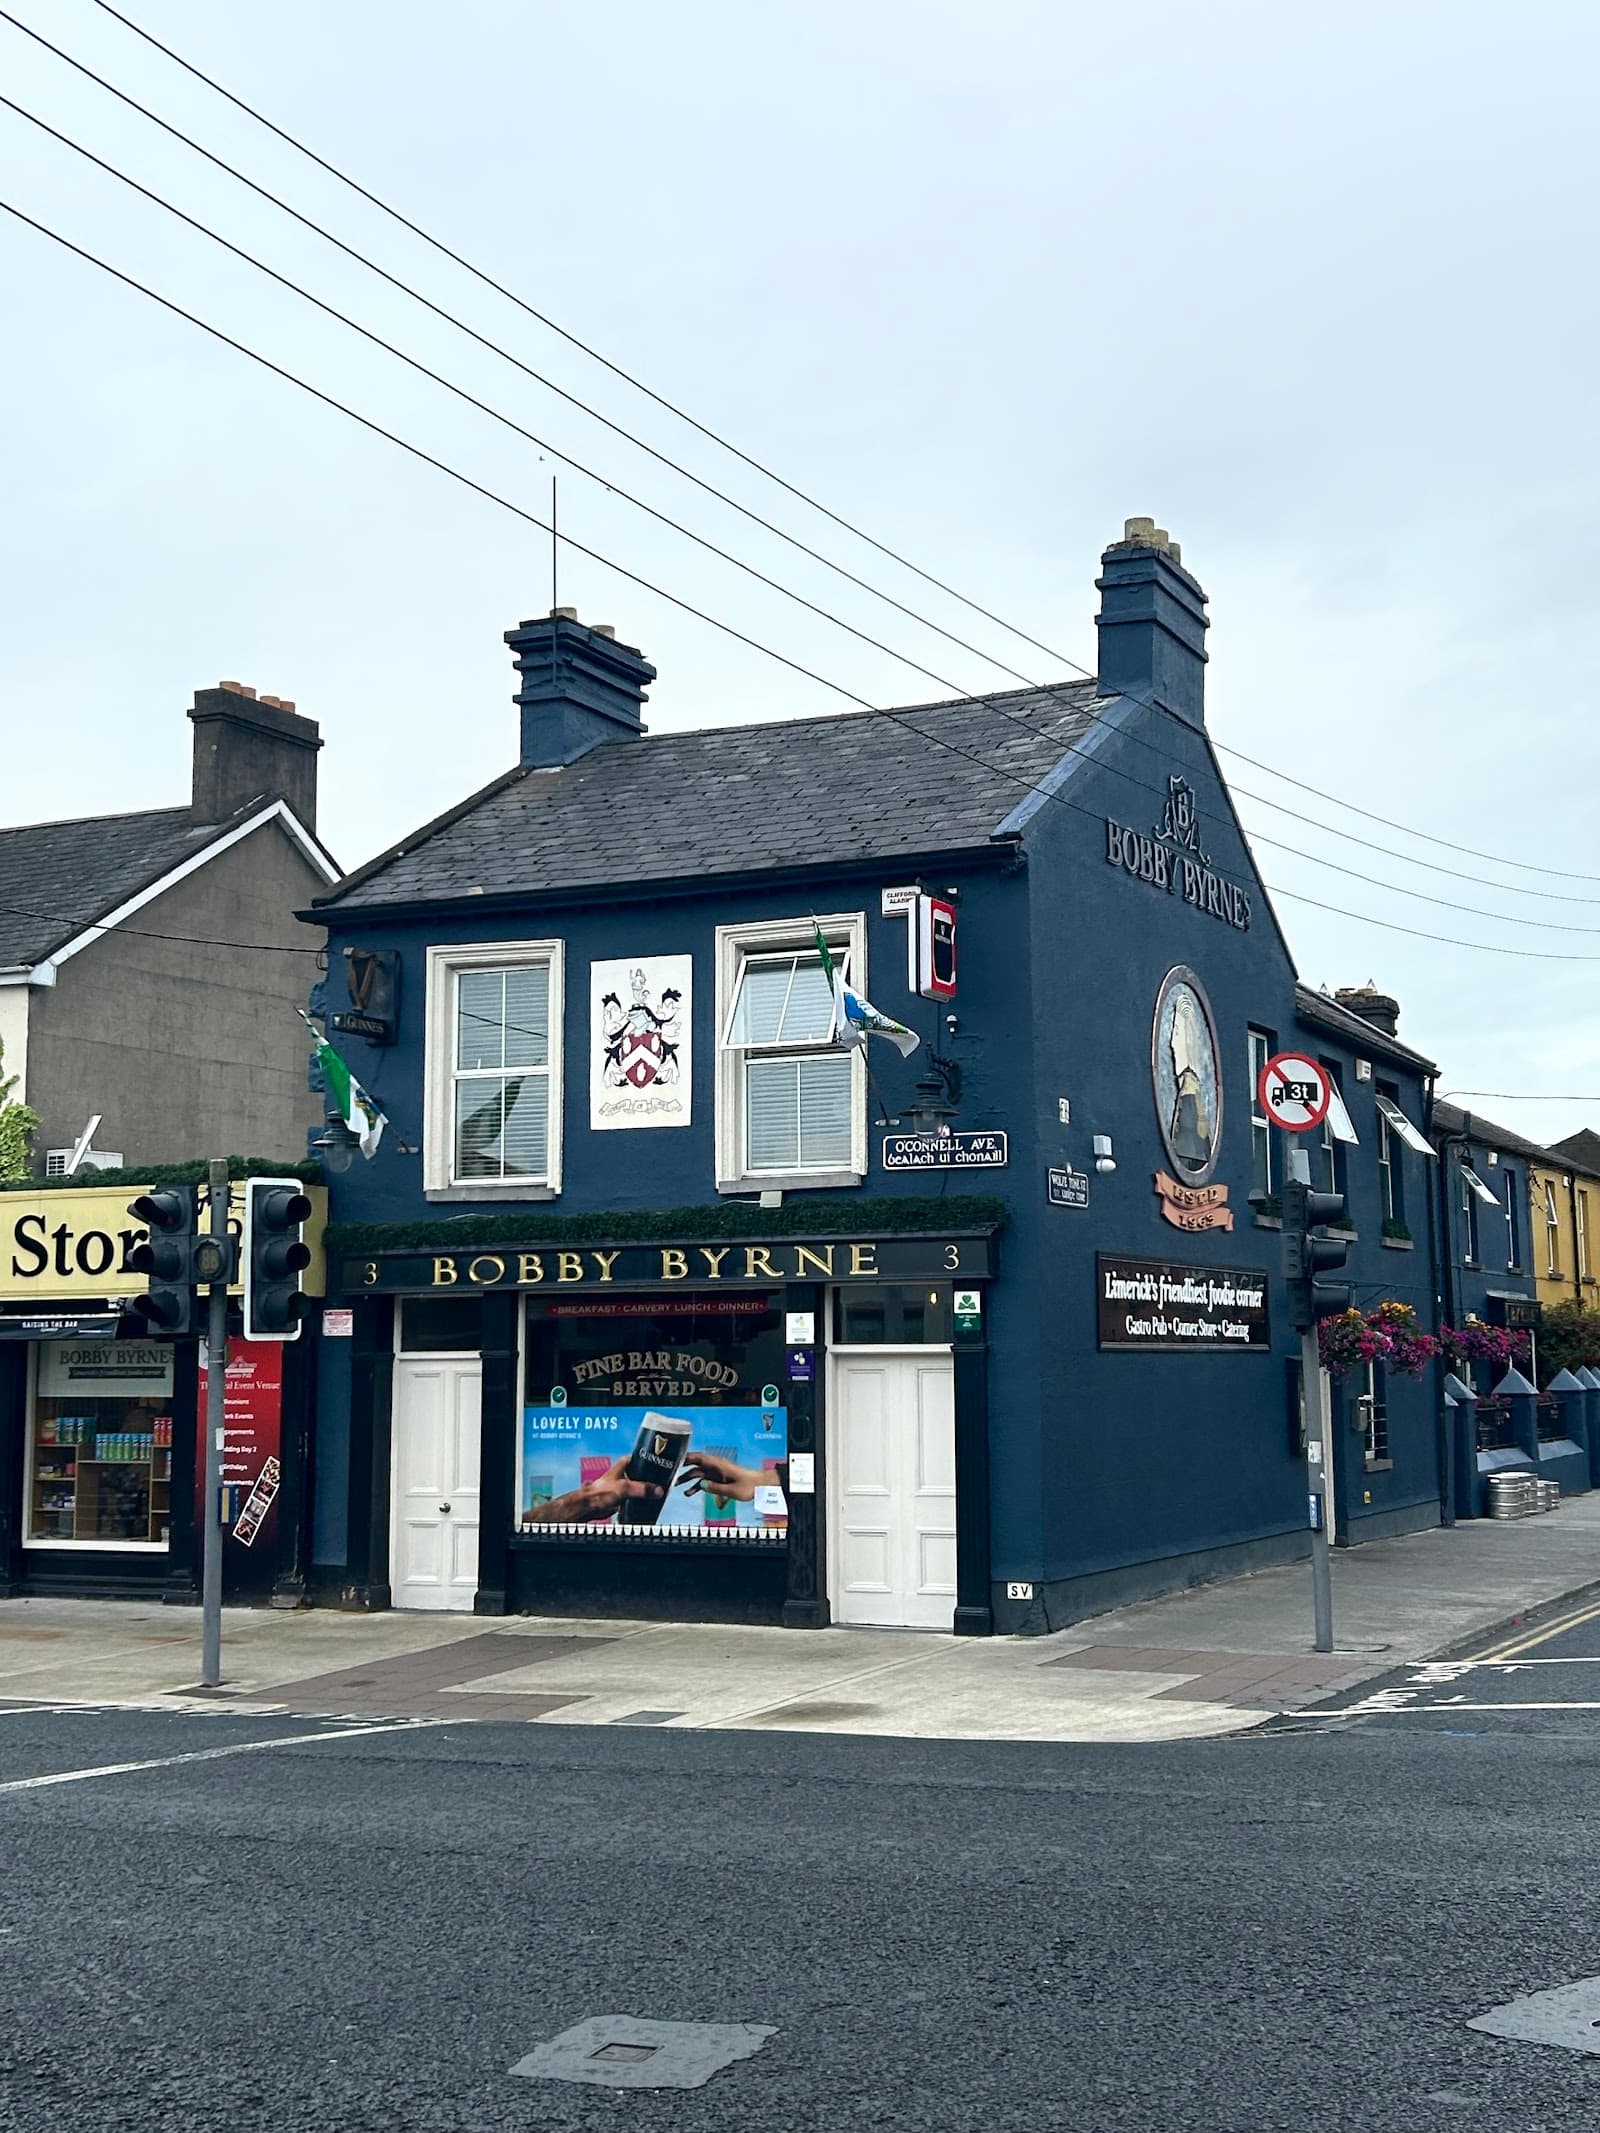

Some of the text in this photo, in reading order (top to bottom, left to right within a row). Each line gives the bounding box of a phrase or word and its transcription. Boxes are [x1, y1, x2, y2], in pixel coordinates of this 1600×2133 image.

[1107, 816, 1251, 929] BOBBY BYRNES
[1290, 1084, 1308, 1099] 3t
[895, 1138, 963, 1153] O'CONNELL
[12, 1214, 149, 1278] Stor
[943, 1244, 961, 1270] 3
[363, 1262, 378, 1285] 3
[431, 1243, 881, 1286] BOBBY BYRNE
[1105, 1270, 1263, 1312] Limerick's friendliest foodie corner
[558, 1302, 759, 1314] BREAKFAST CARVERY LUNCH DINNER
[1151, 1315, 1168, 1336] Pub
[60, 1351, 114, 1365] BOBBY
[572, 1351, 739, 1388] FINE BAR FOOD
[613, 1381, 696, 1397] SERVED
[532, 1416, 618, 1430] LOVELY DAYS
[638, 1447, 674, 1469] GUINNESS
